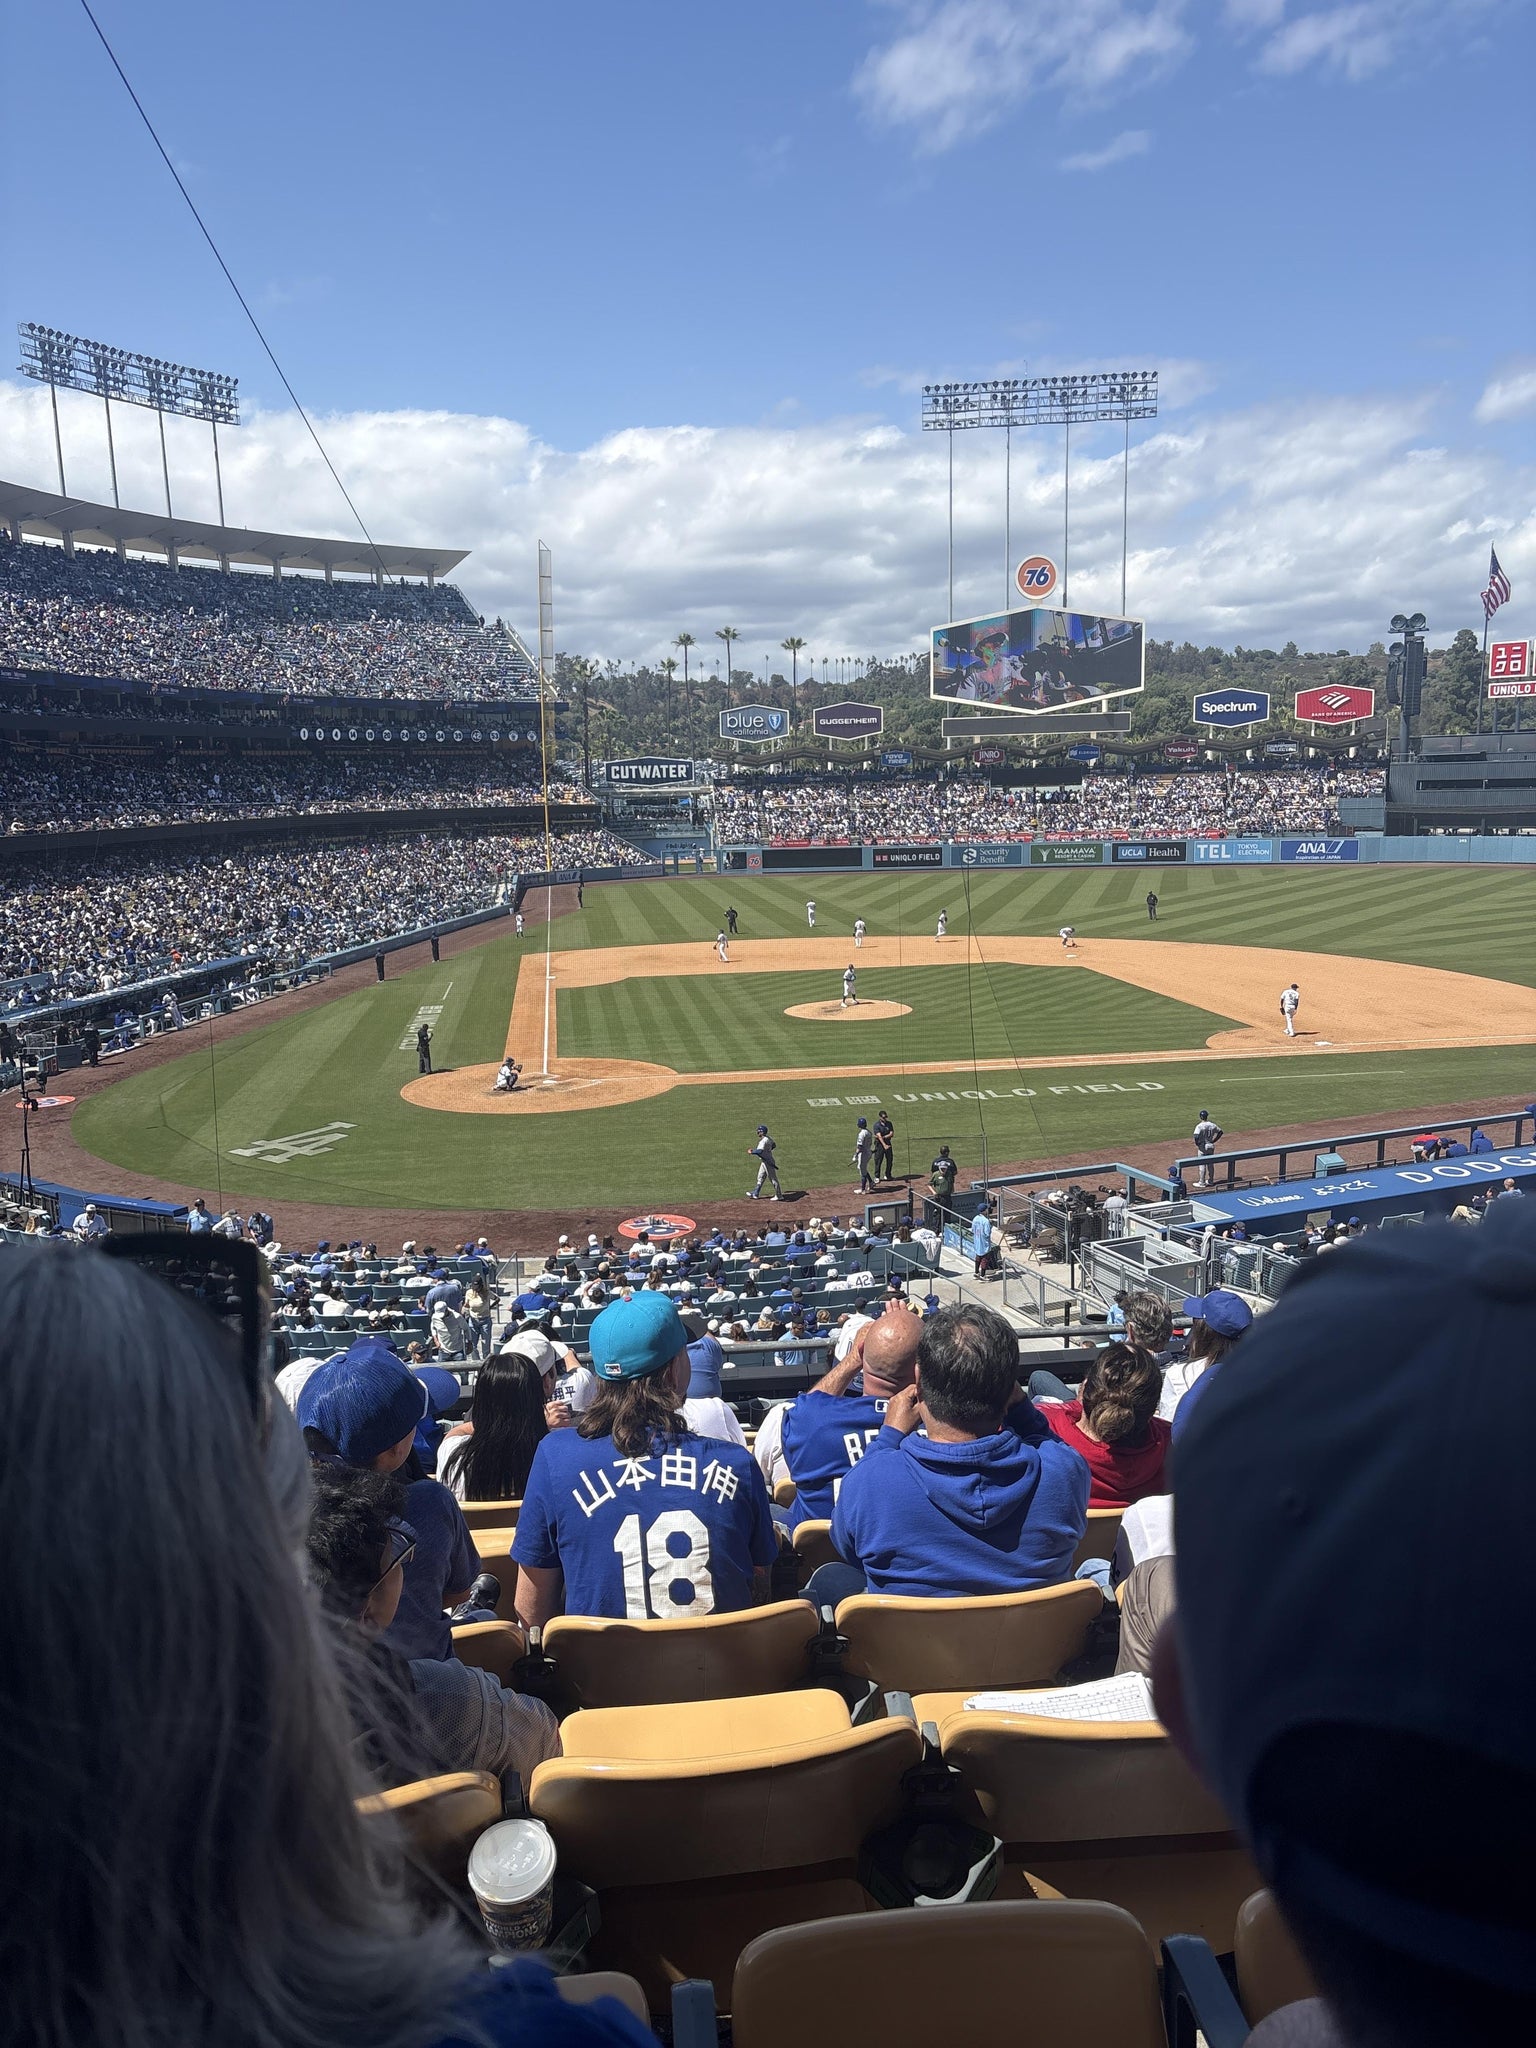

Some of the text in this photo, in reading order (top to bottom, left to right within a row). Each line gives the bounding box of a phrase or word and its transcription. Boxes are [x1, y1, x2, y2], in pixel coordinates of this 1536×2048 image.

[1024, 566, 1049, 587] 76
[1493, 684, 1532, 696] UNIQLO
[1202, 701, 1257, 715] Spectrum
[726, 713, 764, 728] blue
[819, 716, 878, 726] GUGGENHEIM
[733, 728, 769, 736] california
[980, 750, 1000, 759] JINRO
[611, 764, 687, 780] CUTWATER
[979, 848, 1010, 859] Security
[1121, 847, 1180, 858] UCLA Health
[1197, 844, 1231, 859] TEL
[1238, 848, 1270, 856] ELECTRON
[1296, 842, 1326, 854] ANA
[750, 857, 760, 866] 76
[890, 853, 941, 862] UNIQLO FIELD
[980, 855, 1006, 864] Benefit
[893, 1088, 1038, 1102] UNIQLO
[1047, 1081, 1166, 1095] FIELD
[1395, 1152, 1536, 1184] DODG
[1237, 1194, 1304, 1207] Welcome
[856, 1275, 870, 1287] 42
[572, 1448, 740, 1518] 山本由伸
[613, 1509, 715, 1620] 18
